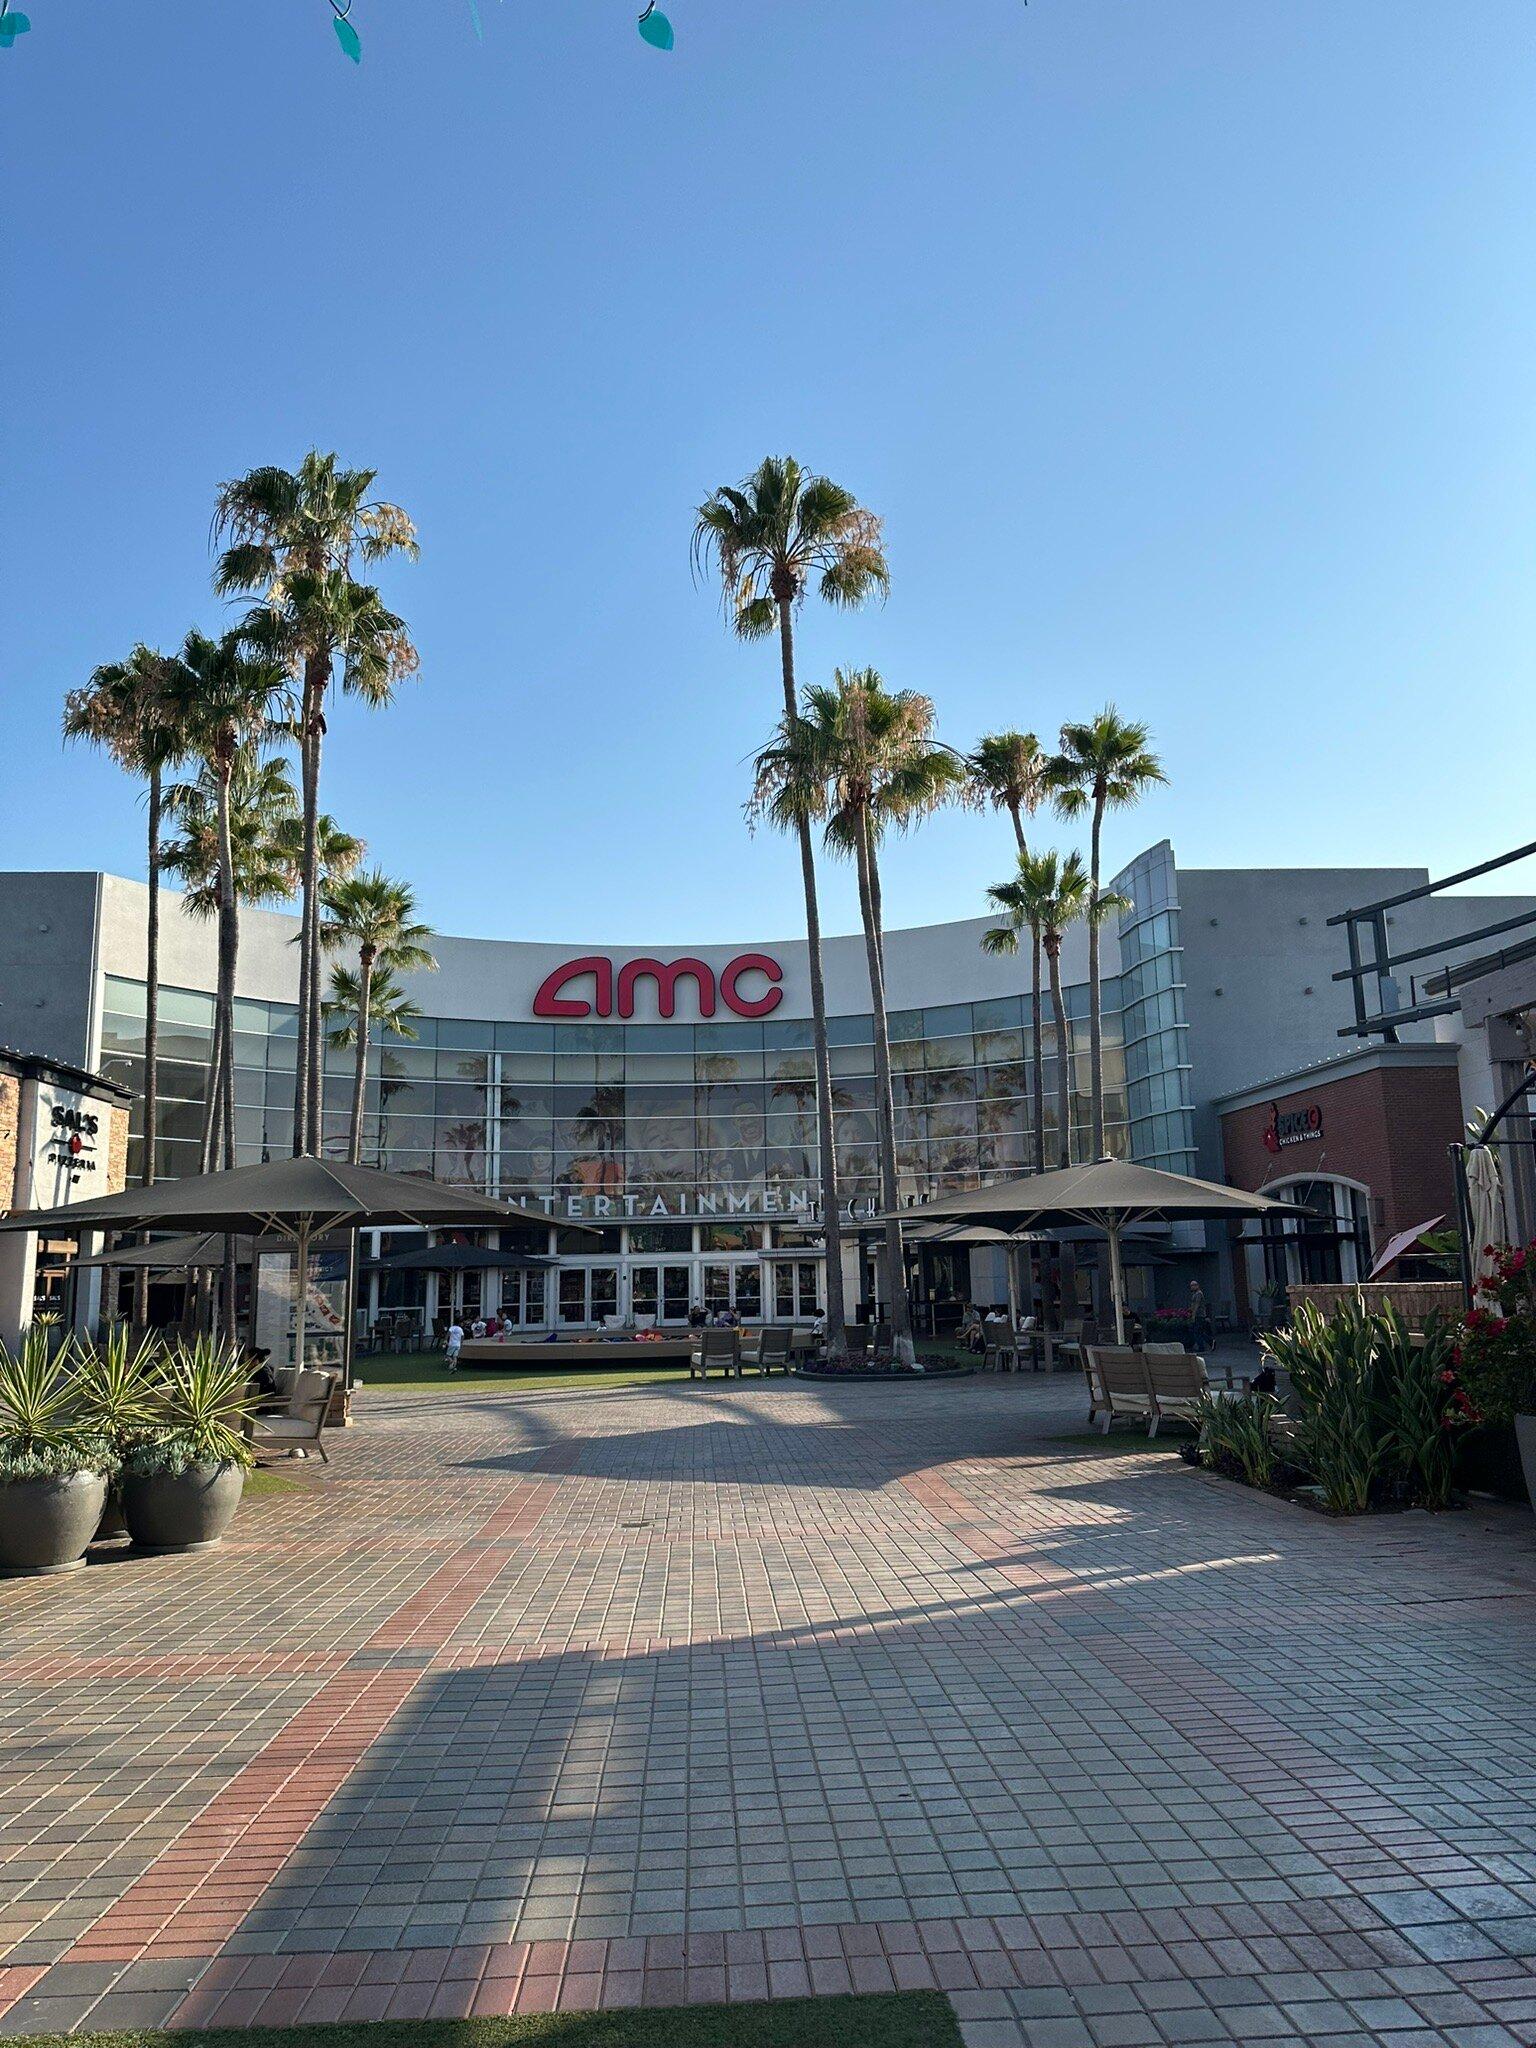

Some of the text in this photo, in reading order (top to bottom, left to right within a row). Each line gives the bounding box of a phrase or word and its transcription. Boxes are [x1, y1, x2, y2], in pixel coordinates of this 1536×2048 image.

[47, 1152, 97, 1172] PIZZERIA
[507, 1189, 809, 1218] NTERTAINMEN
[276, 1233, 330, 1242] DIRORY
